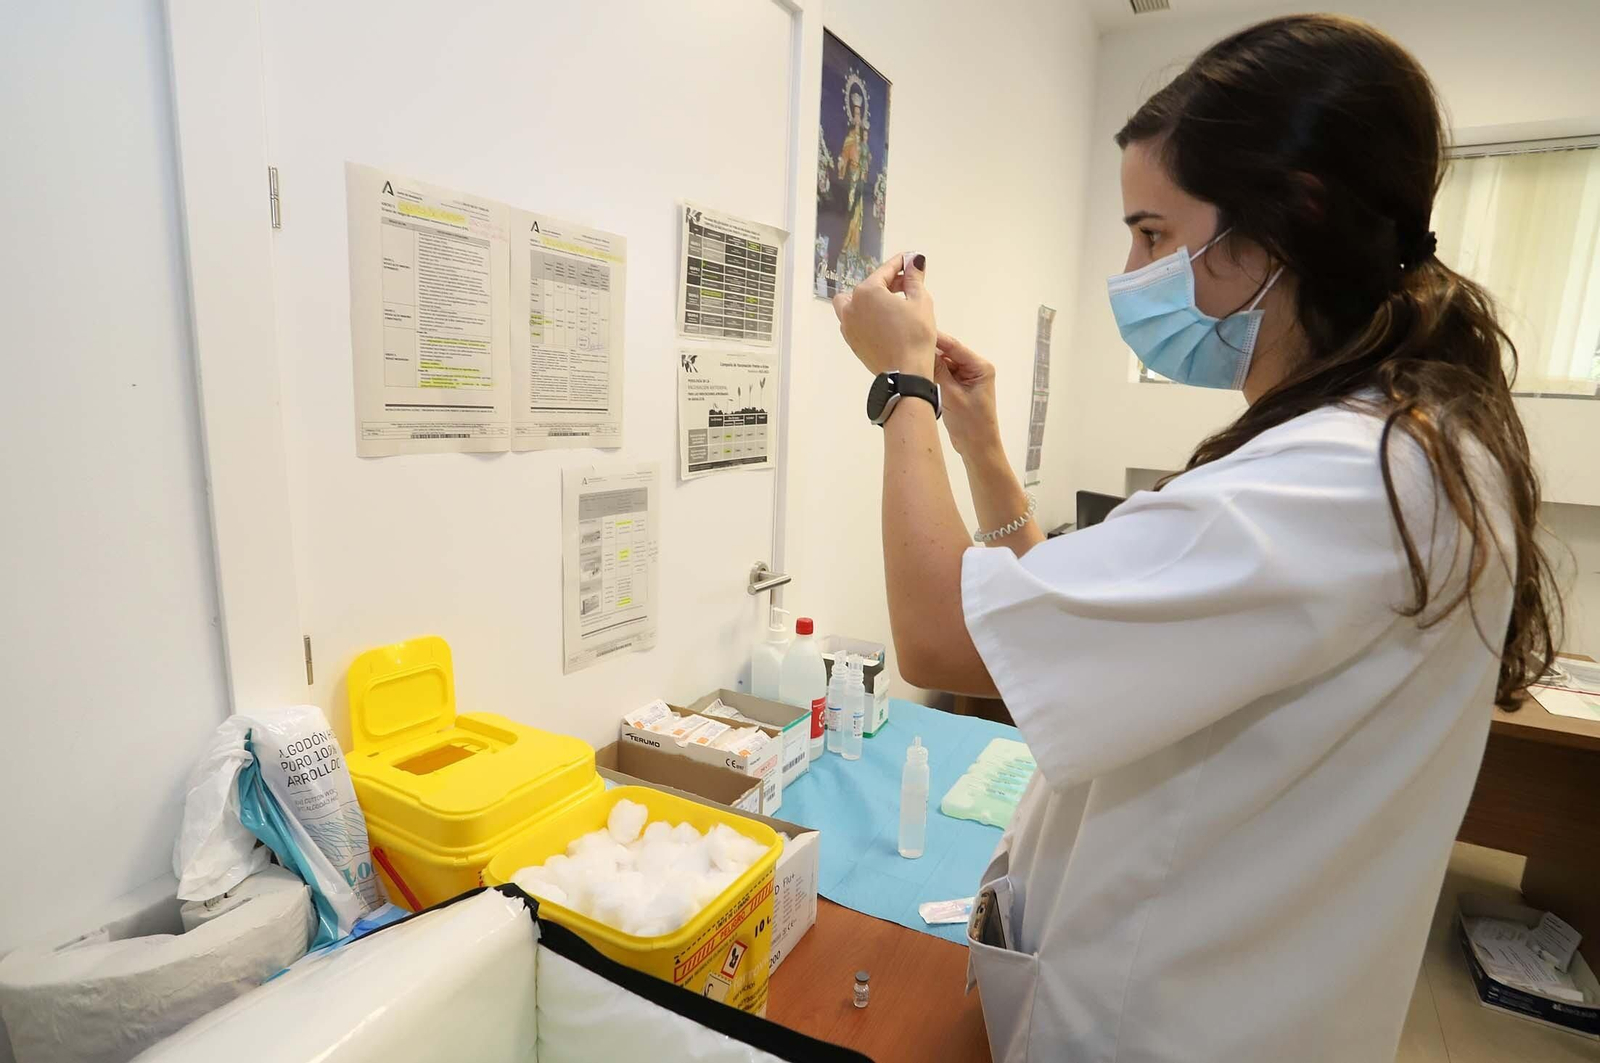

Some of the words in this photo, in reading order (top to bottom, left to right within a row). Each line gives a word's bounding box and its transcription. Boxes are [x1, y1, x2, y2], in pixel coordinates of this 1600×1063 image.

[630, 735, 660, 748] TERUMO
[280, 754, 312, 772] PURO
[720, 911, 745, 940] PELIGRO
[755, 918, 764, 938] 10
[769, 950, 780, 968] 200
